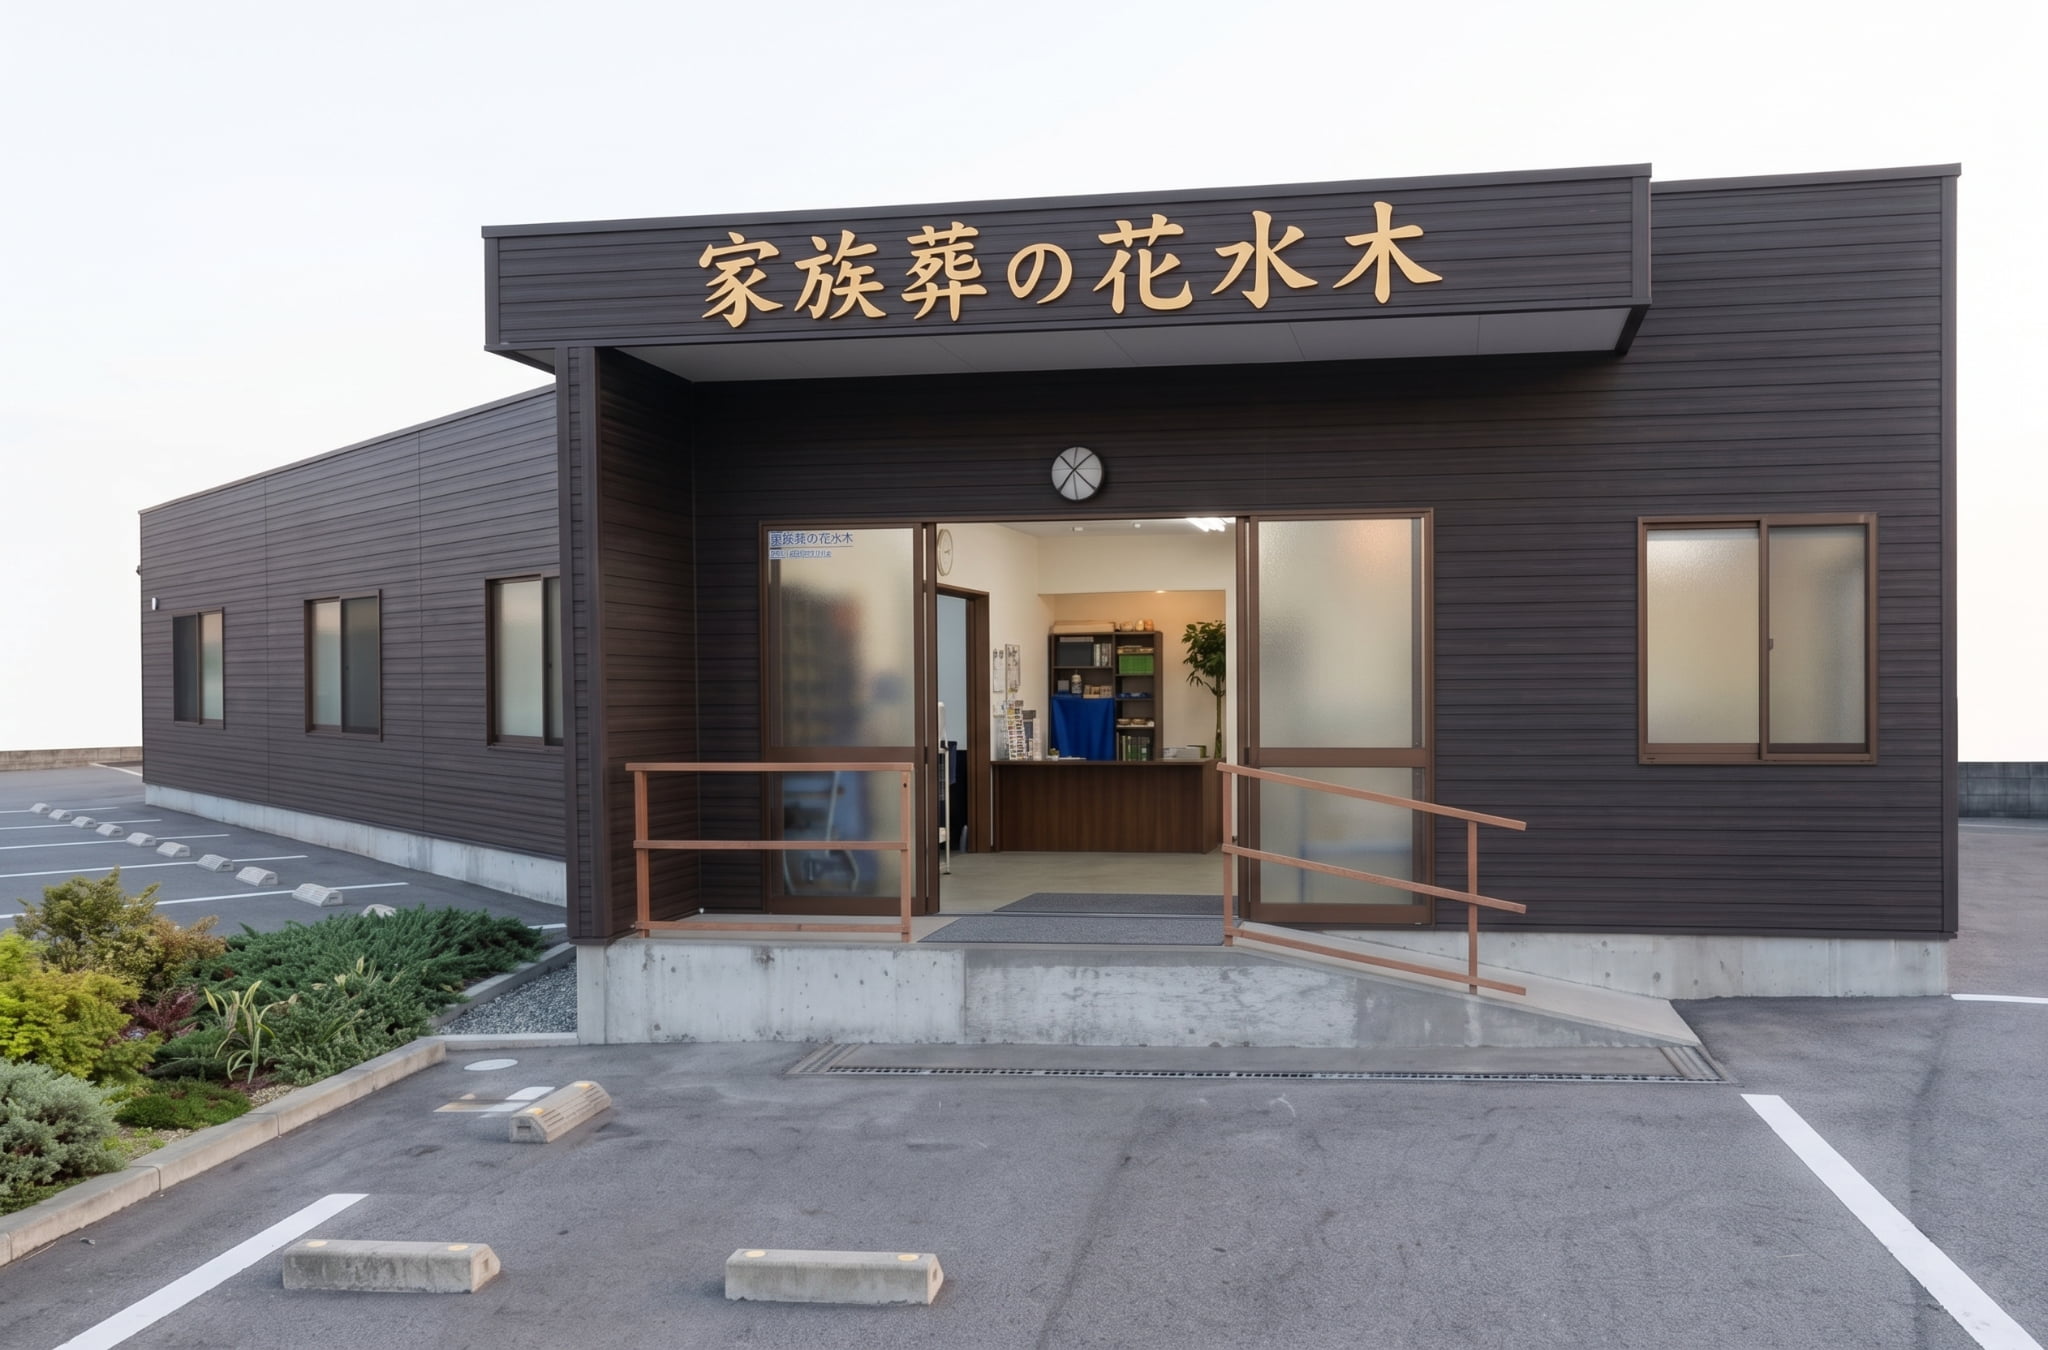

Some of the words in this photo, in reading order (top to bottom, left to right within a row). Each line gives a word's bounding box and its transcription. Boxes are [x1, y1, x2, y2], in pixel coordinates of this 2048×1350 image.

[699, 201, 1442, 328] 家族葬の花水木
